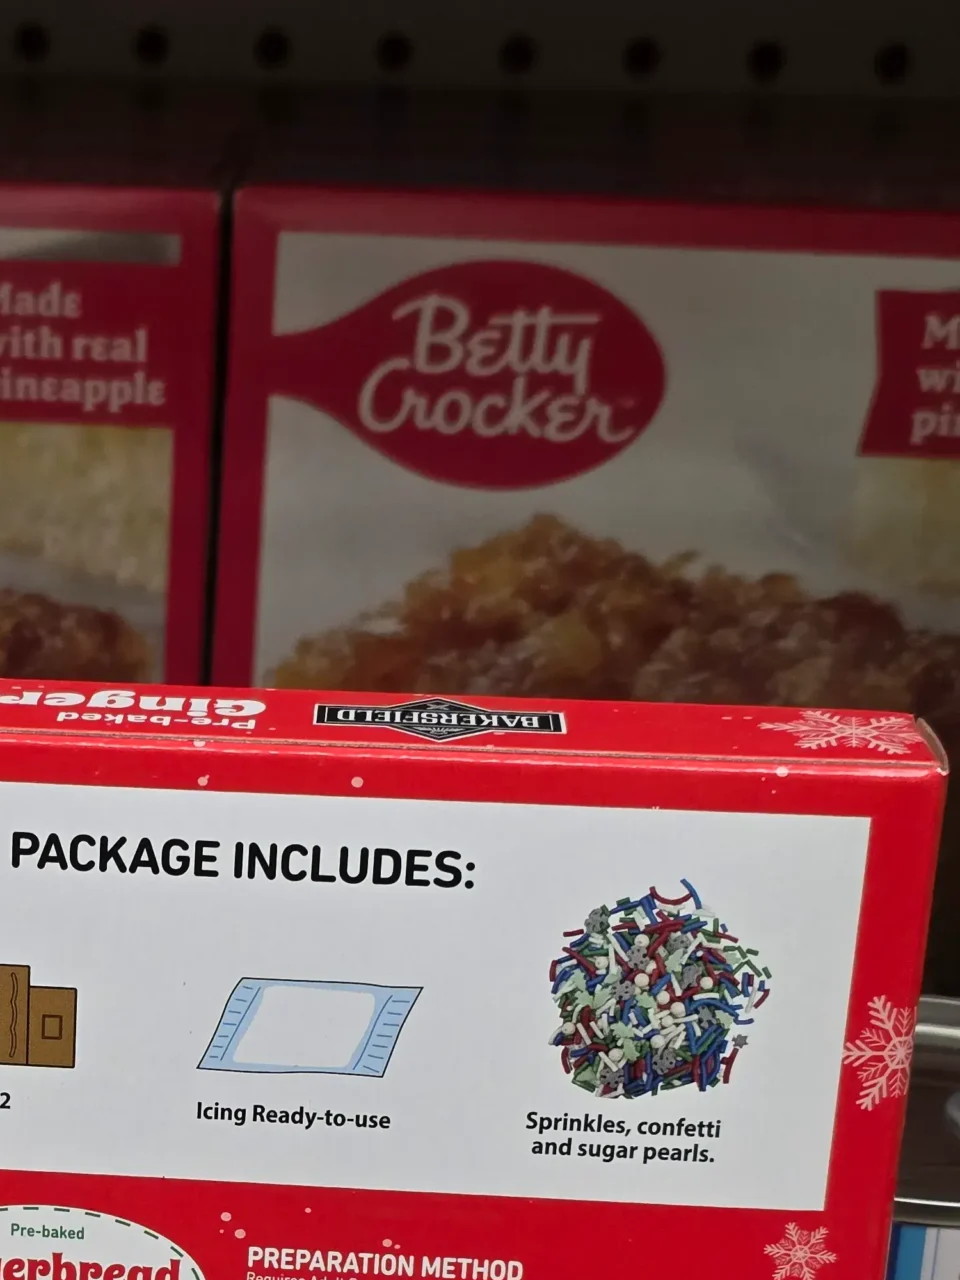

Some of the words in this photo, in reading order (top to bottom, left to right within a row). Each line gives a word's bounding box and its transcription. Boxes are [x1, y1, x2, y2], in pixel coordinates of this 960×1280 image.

[71, 328, 149, 364] real
[392, 294, 602, 397] Betty
[358, 358, 634, 444] Crocker
[57, 711, 257, 731] Pre-baked
[336, 709, 540, 729] BAKERSFIELD
[12, 831, 221, 878] PACKAGE
[235, 841, 476, 889] INCLUDES:
[197, 1101, 246, 1126] Icing
[253, 1105, 390, 1130] Ready-to-use
[526, 1111, 630, 1137] Sprinkles,
[638, 1117, 720, 1138] confetti
[532, 1137, 572, 1156] and
[578, 1143, 638, 1163] sugar
[644, 1143, 714, 1164] pearls.
[11, 1223, 84, 1239] Pre-baked
[248, 1246, 414, 1277] PREPARATION
